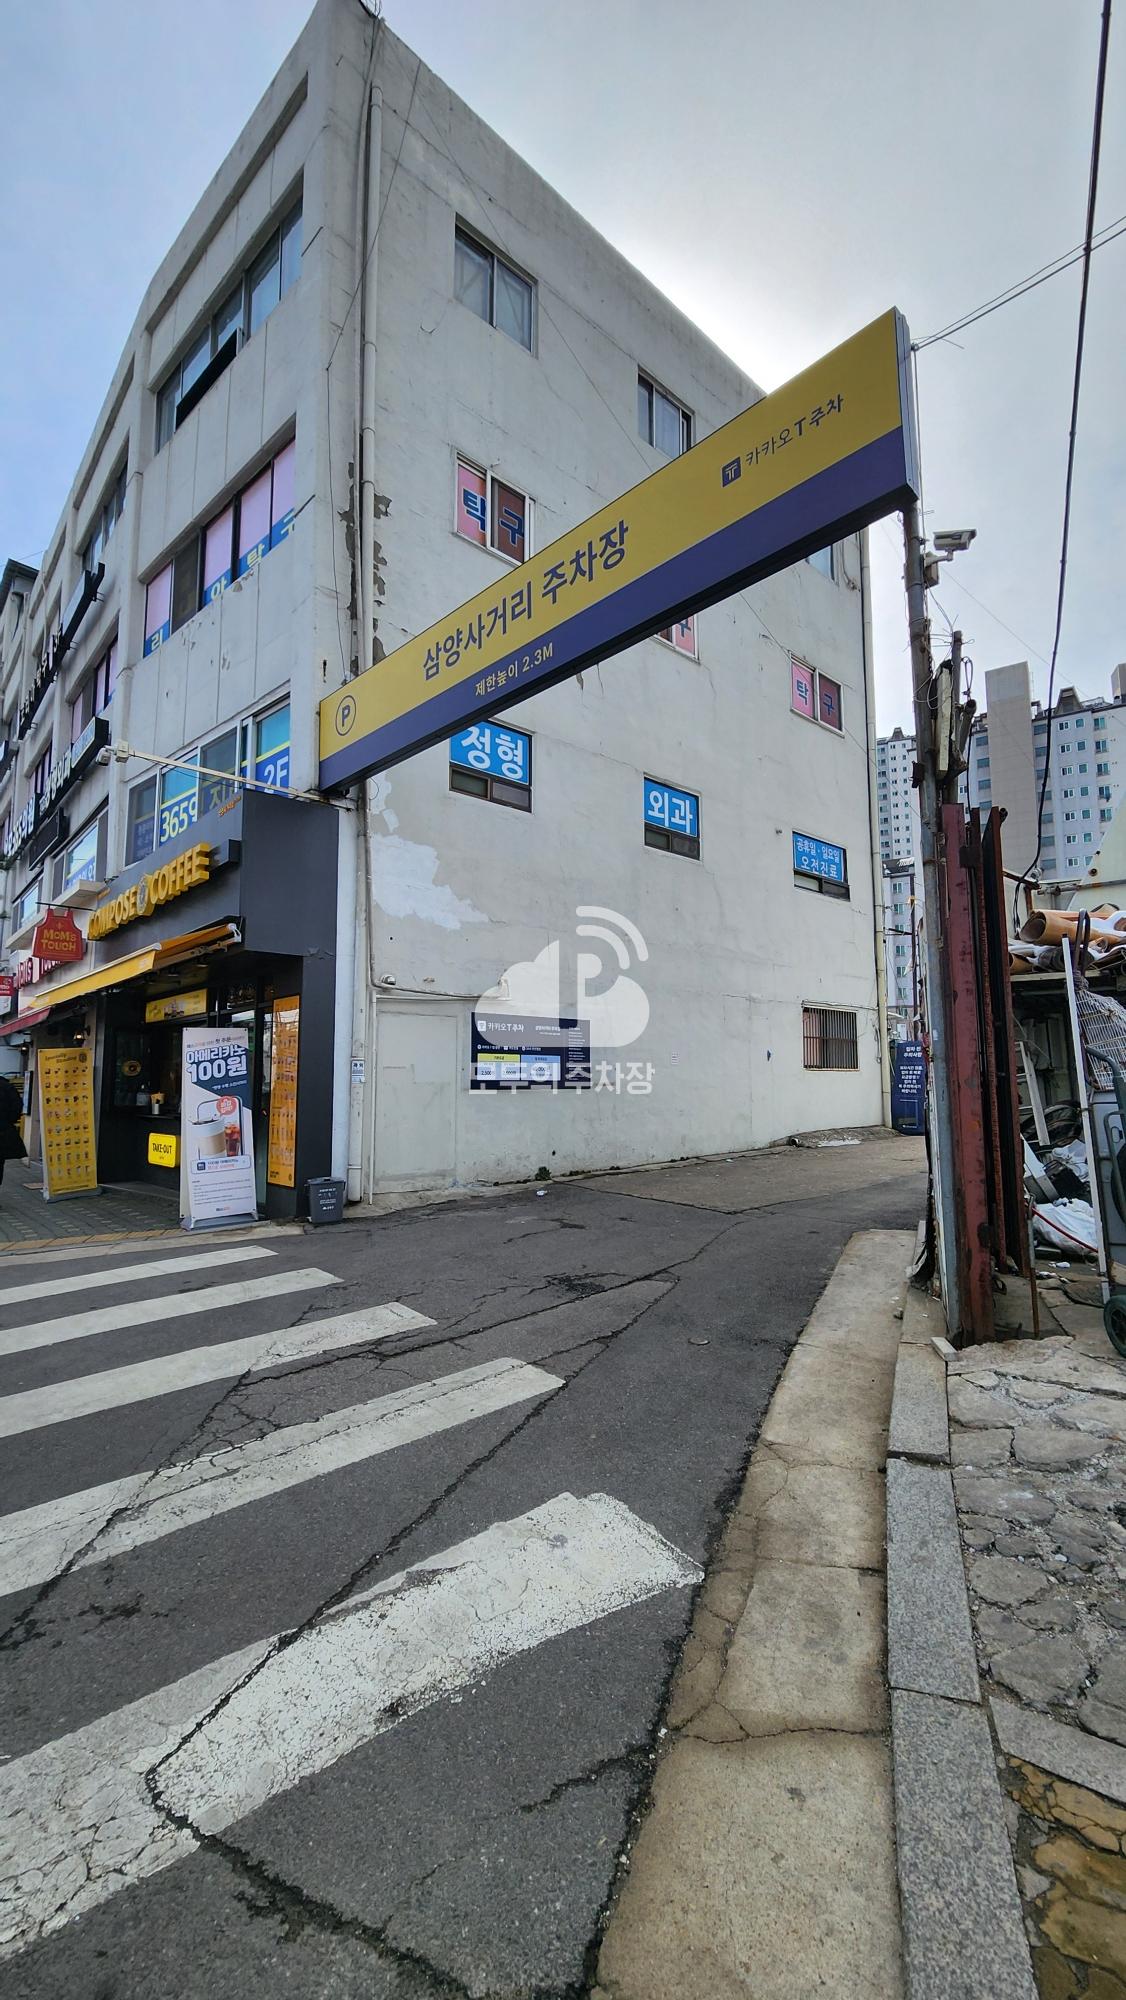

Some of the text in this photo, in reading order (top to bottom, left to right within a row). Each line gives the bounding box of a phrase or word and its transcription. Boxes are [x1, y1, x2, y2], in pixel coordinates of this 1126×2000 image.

[423, 519, 629, 681] 삼양사거리 주차장
[475, 642, 554, 697] 제한높이 2.3M
[264, 755, 289, 795] 2F
[460, 726, 524, 780] 정형
[647, 790, 693, 834] 외과
[88, 885, 139, 940] COMPOSE
[150, 843, 210, 905] COFFEE
[41, 939, 77, 952] TOUCH
[186, 1044, 247, 1064] 아메리카노
[186, 1055, 248, 1083] 100원
